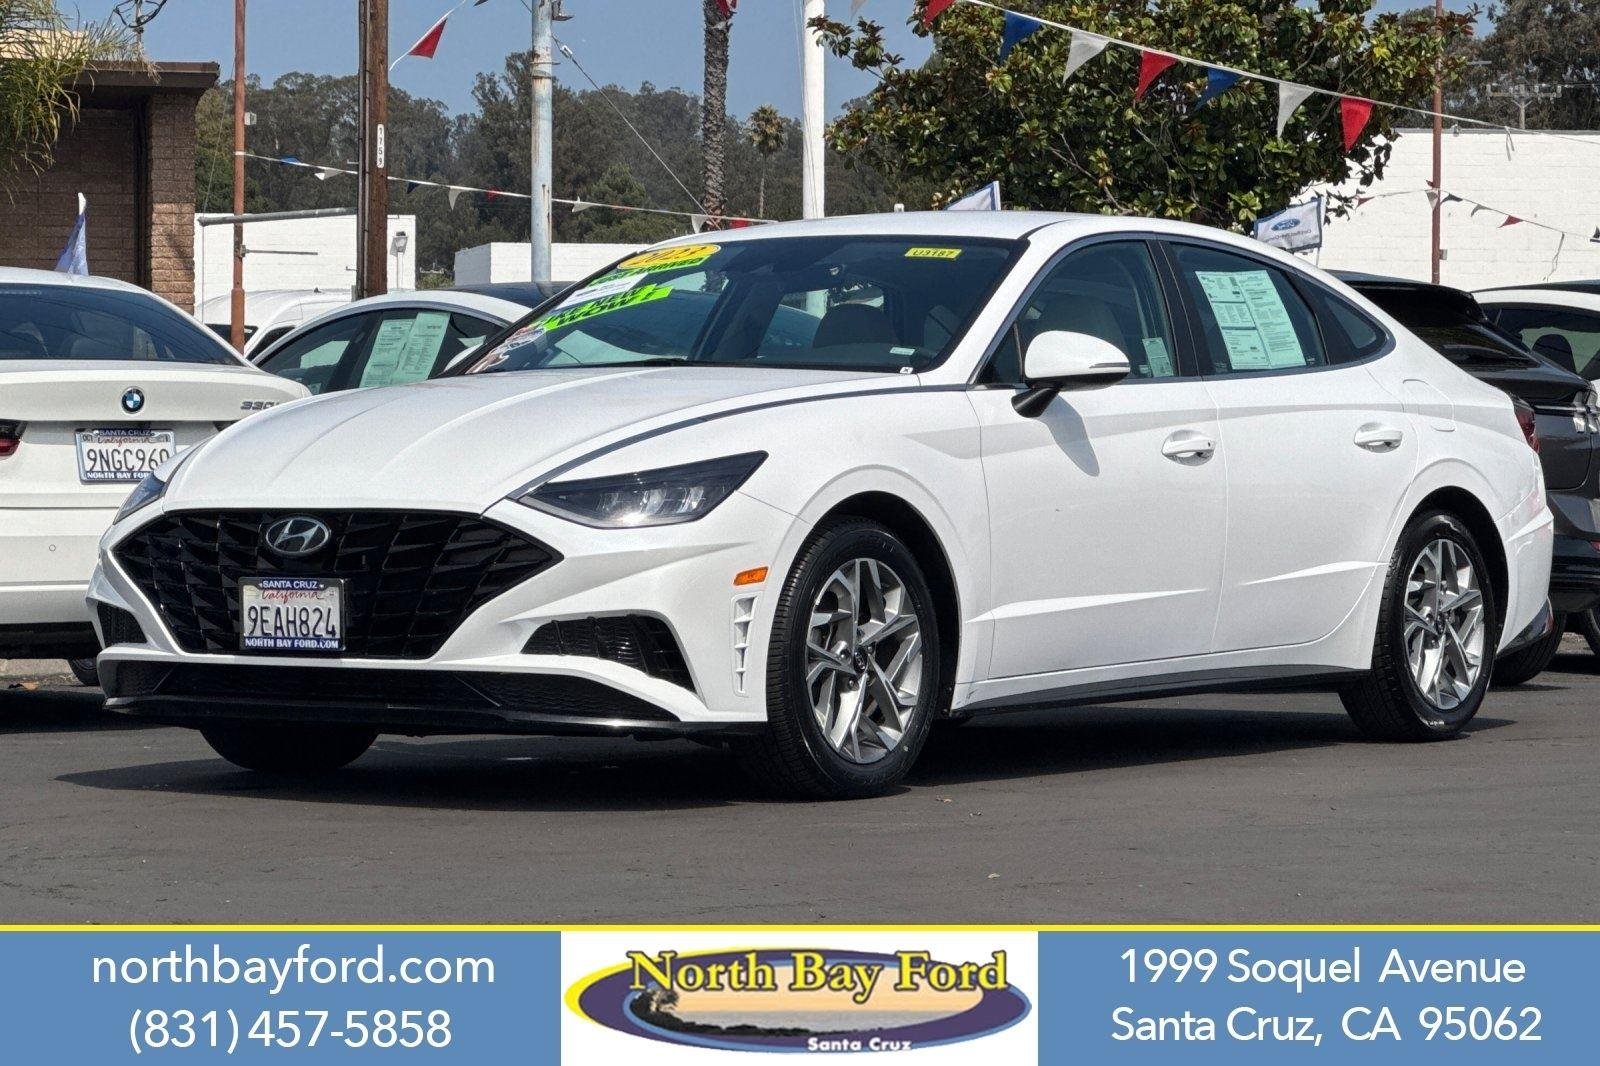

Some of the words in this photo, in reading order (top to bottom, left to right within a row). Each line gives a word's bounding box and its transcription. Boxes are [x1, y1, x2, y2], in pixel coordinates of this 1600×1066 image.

[262, 580, 291, 589] SANTA
[293, 580, 318, 589] CRUZ
[262, 590, 324, 603] California
[247, 605, 336, 638] 9EAH824
[245, 638, 275, 647] NORTH
[276, 639, 293, 648] BAY
[294, 640, 339, 649] FORD.COM
